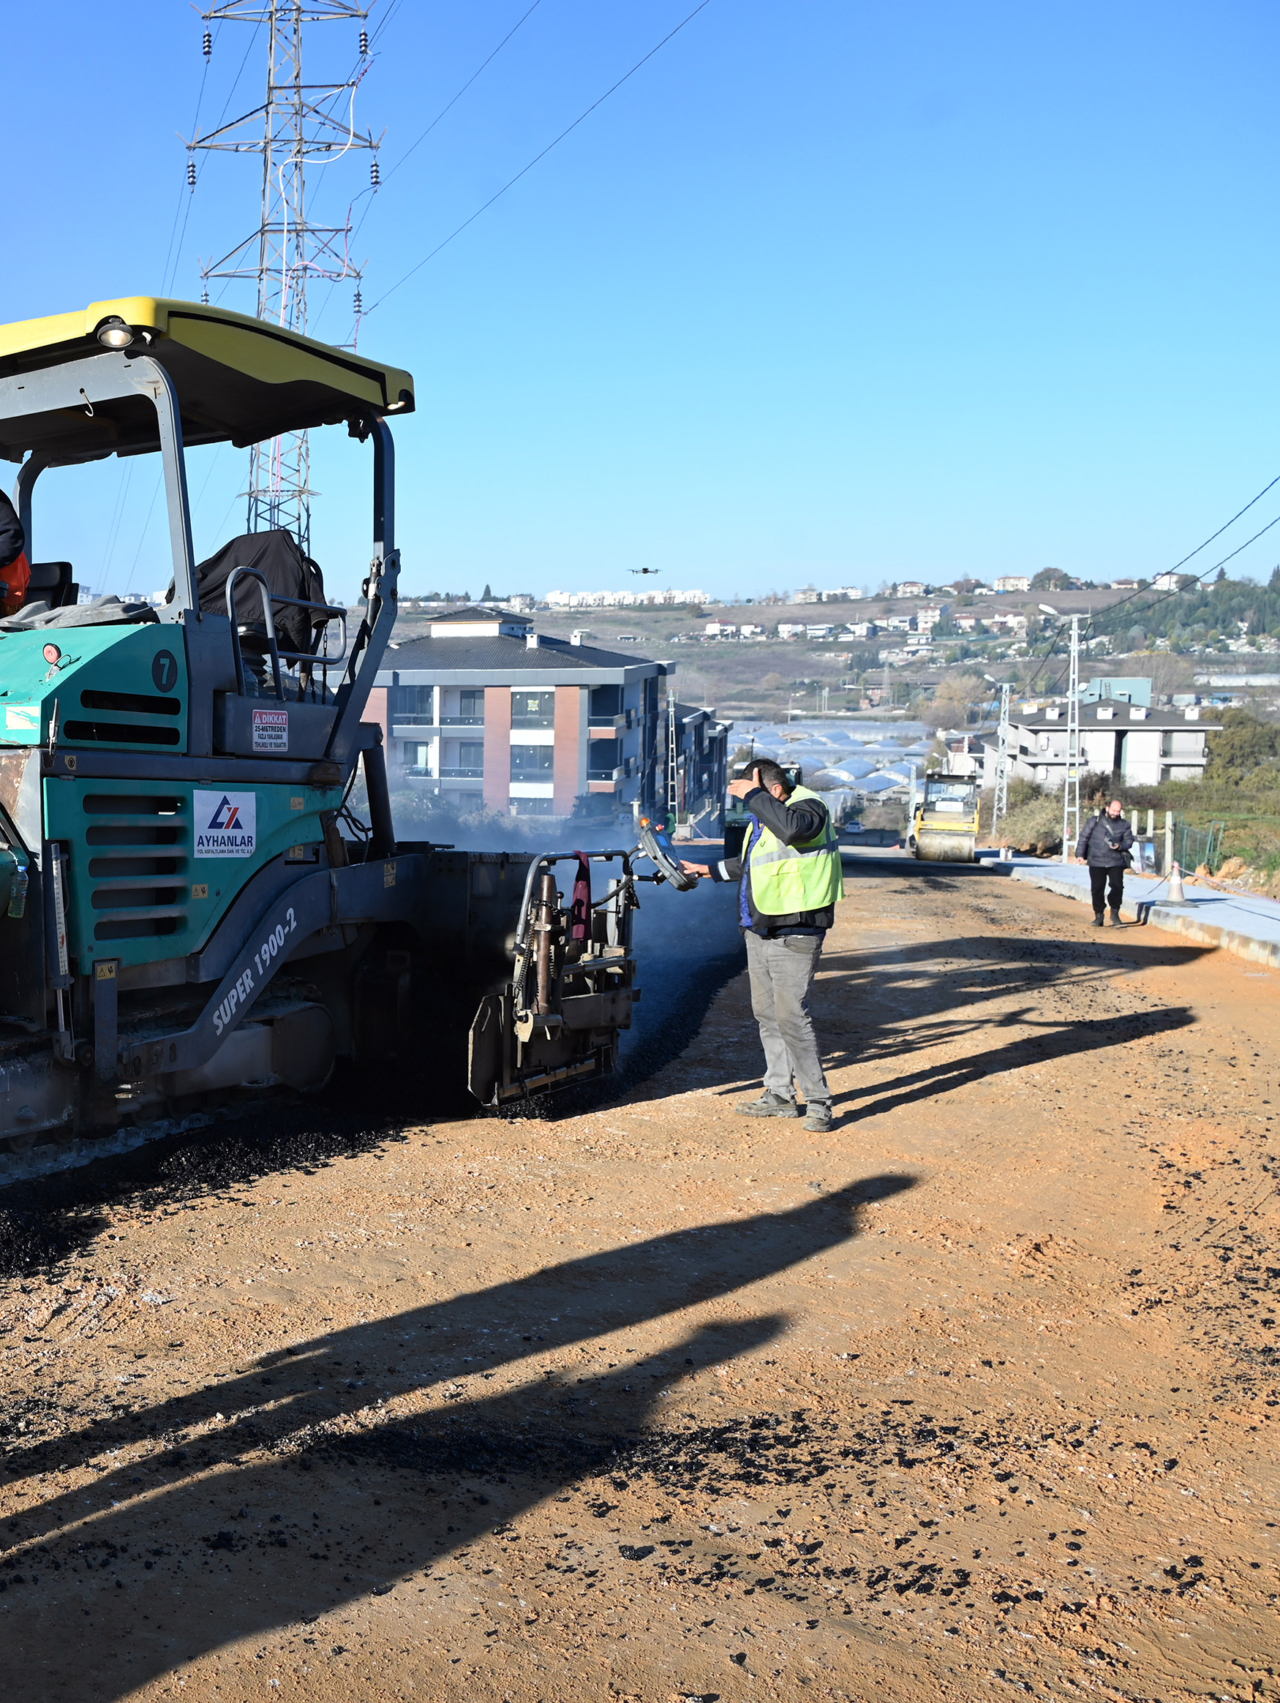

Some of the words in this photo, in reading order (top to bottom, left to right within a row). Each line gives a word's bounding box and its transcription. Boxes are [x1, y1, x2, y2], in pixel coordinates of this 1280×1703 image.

[160, 658, 170, 685] 7
[262, 713, 287, 724] DİKKAT
[197, 835, 253, 847] AYHANLAR
[212, 968, 255, 1036] SUPER
[254, 907, 297, 976] 1900-2
